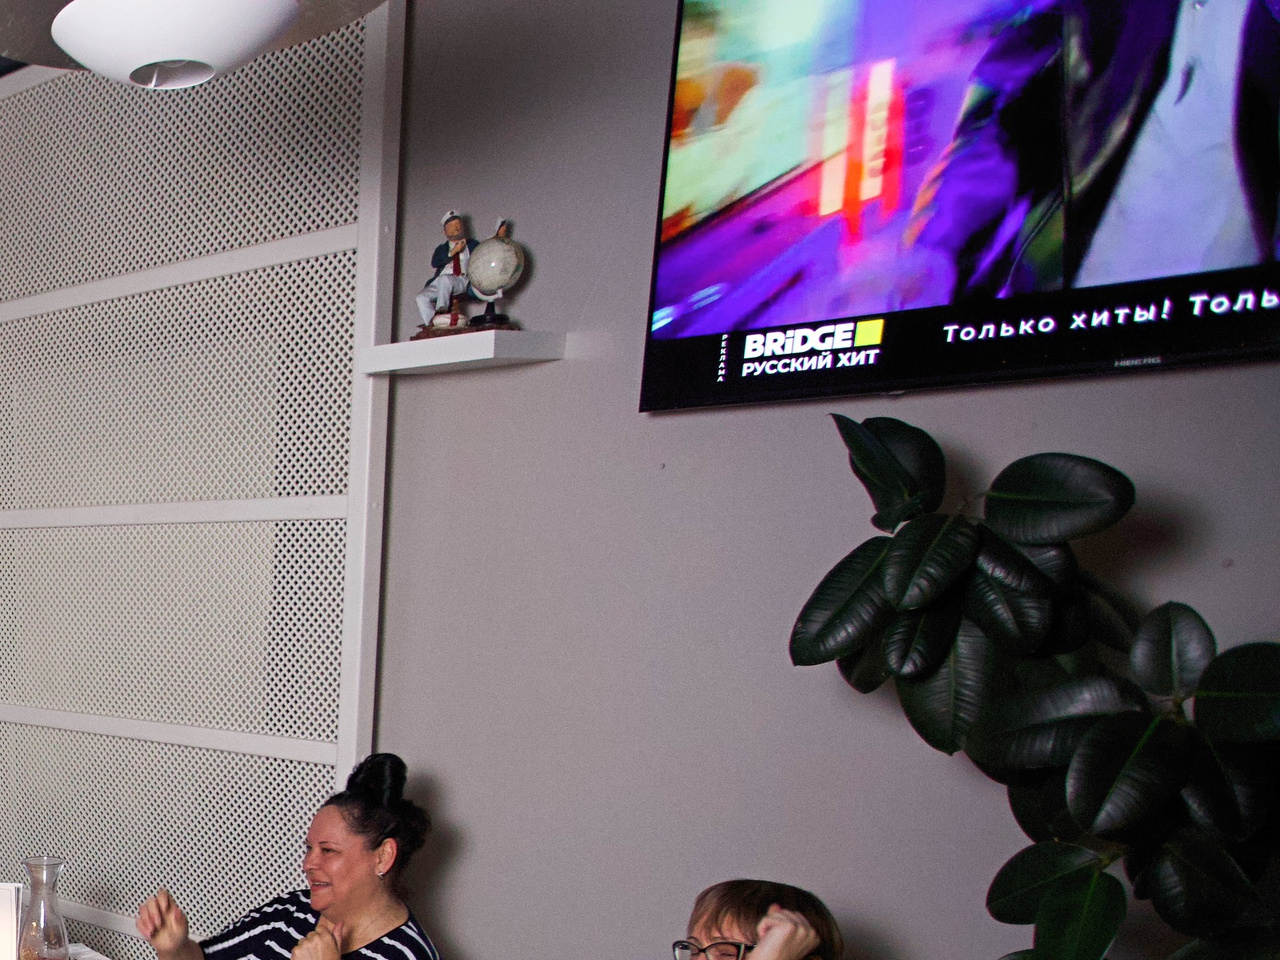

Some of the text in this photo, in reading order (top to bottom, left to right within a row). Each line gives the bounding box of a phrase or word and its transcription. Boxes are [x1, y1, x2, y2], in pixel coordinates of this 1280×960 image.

[943, 288, 1280, 343] Только хиты! Толь
[717, 334, 729, 382] РЕКЛАМА
[741, 349, 880, 377] РУССКИЙ ХИТ
